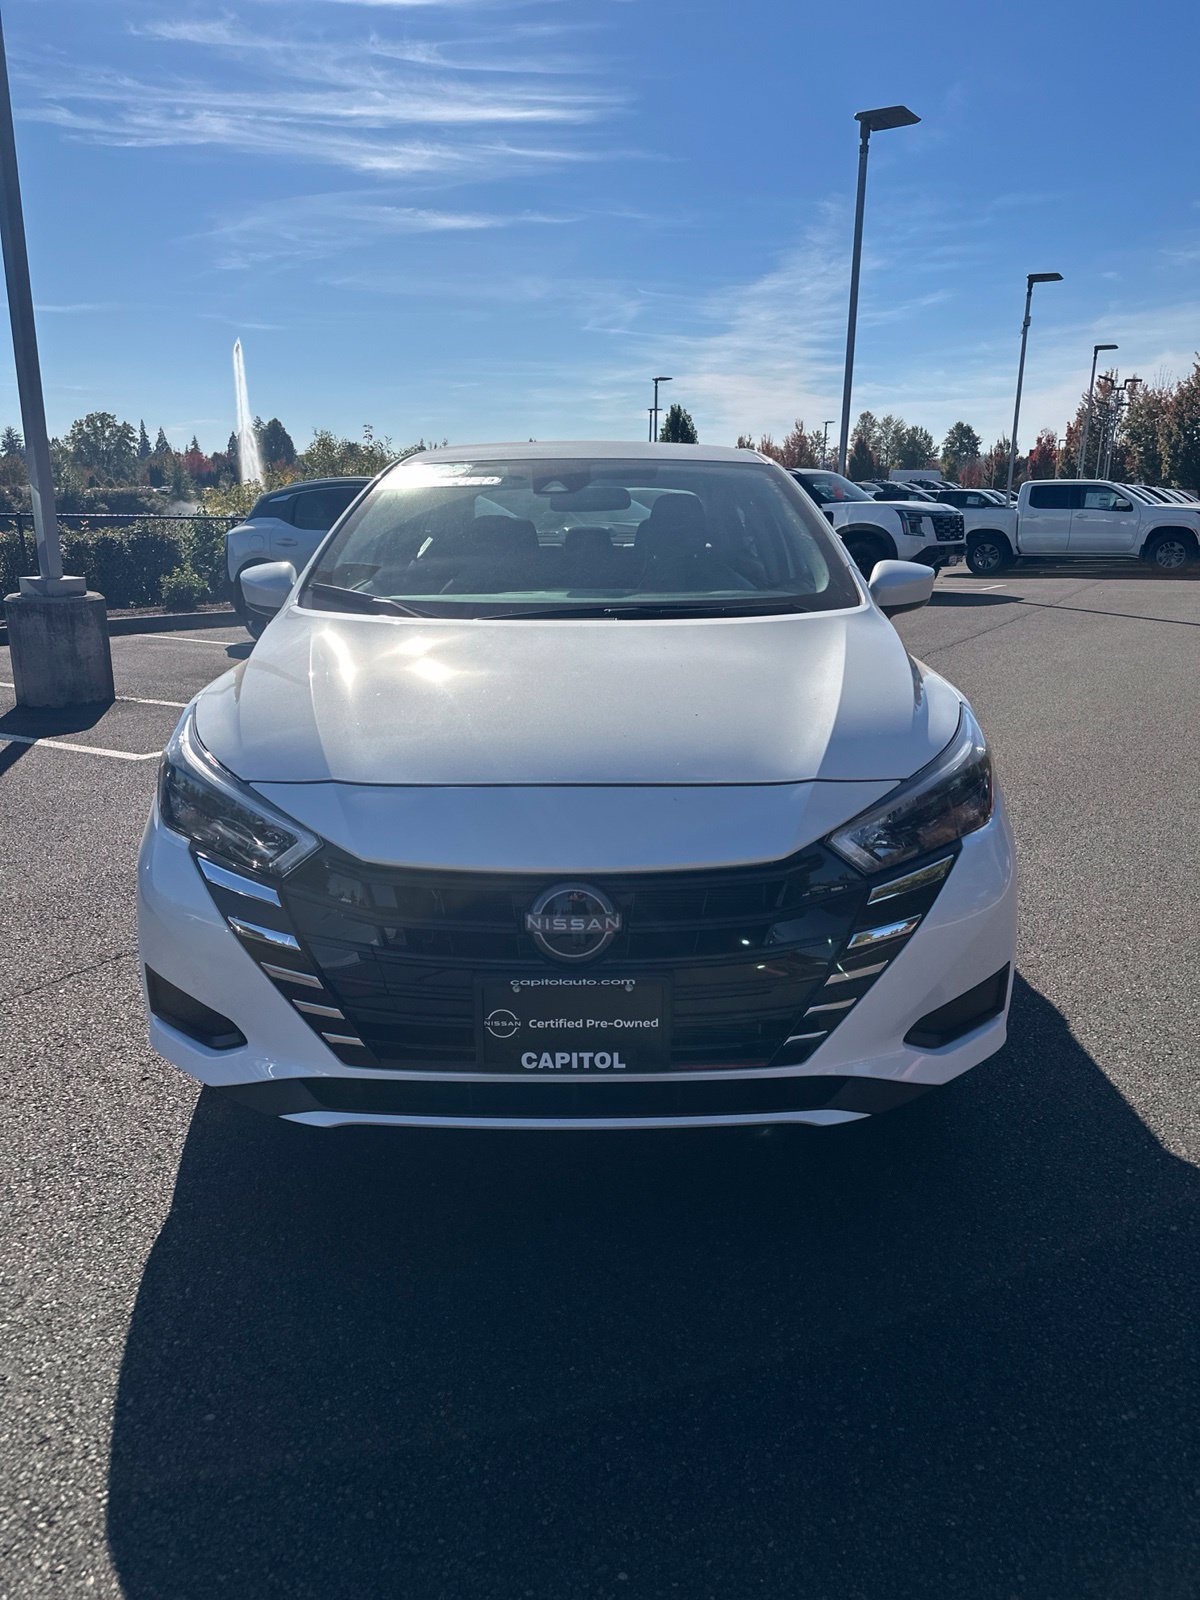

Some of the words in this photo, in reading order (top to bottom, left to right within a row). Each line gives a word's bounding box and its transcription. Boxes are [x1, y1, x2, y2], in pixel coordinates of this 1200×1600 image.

[526, 914, 621, 931] NISSAN
[510, 978, 636, 987] capitolauto.com
[484, 1019, 521, 1027] NISSAN
[528, 1018, 583, 1029] Certified
[586, 1018, 659, 1029] Pre-Owned
[521, 1051, 626, 1069] CAPITOL
